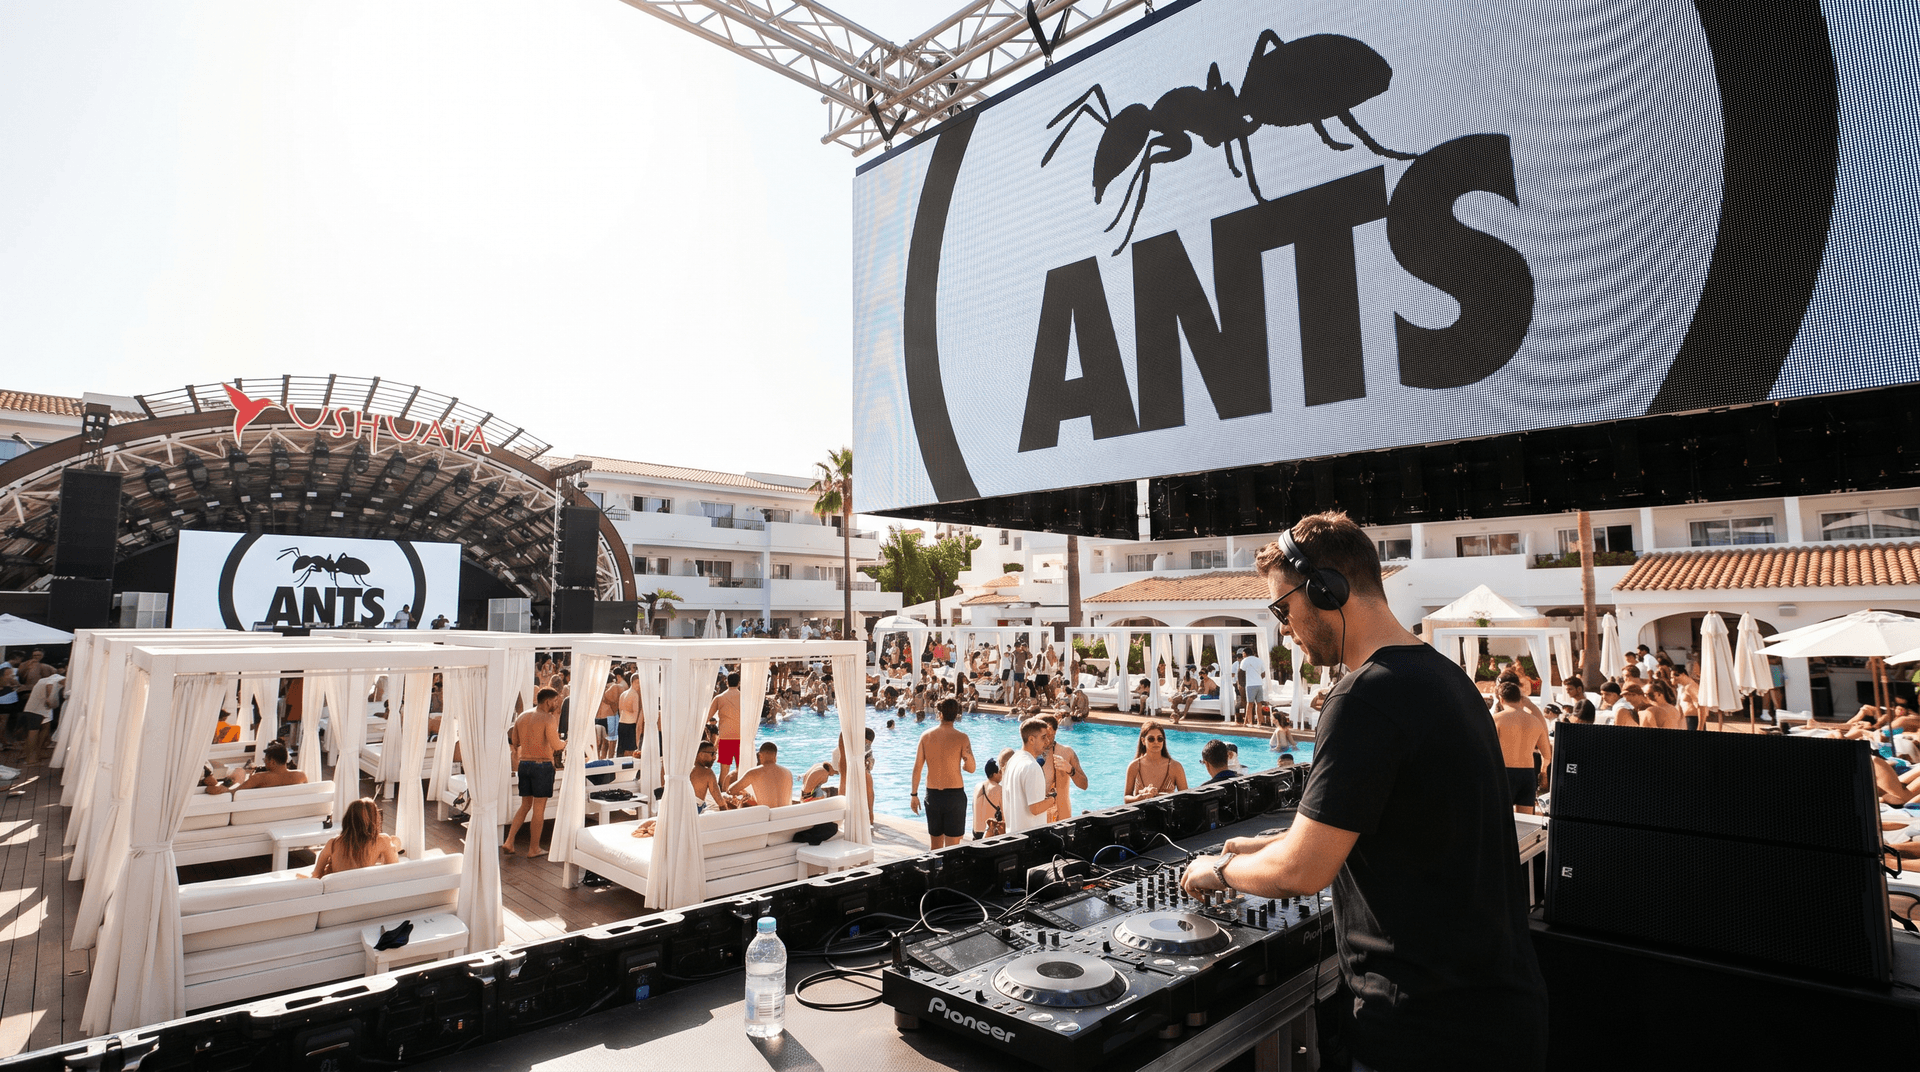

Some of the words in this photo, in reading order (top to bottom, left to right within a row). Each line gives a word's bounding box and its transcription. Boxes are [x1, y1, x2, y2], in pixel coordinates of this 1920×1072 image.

[1017, 132, 1535, 453] ANTS
[286, 402, 493, 455] USHUAÏA
[264, 585, 386, 628] ANTS
[927, 996, 1016, 1043] Pioneer
